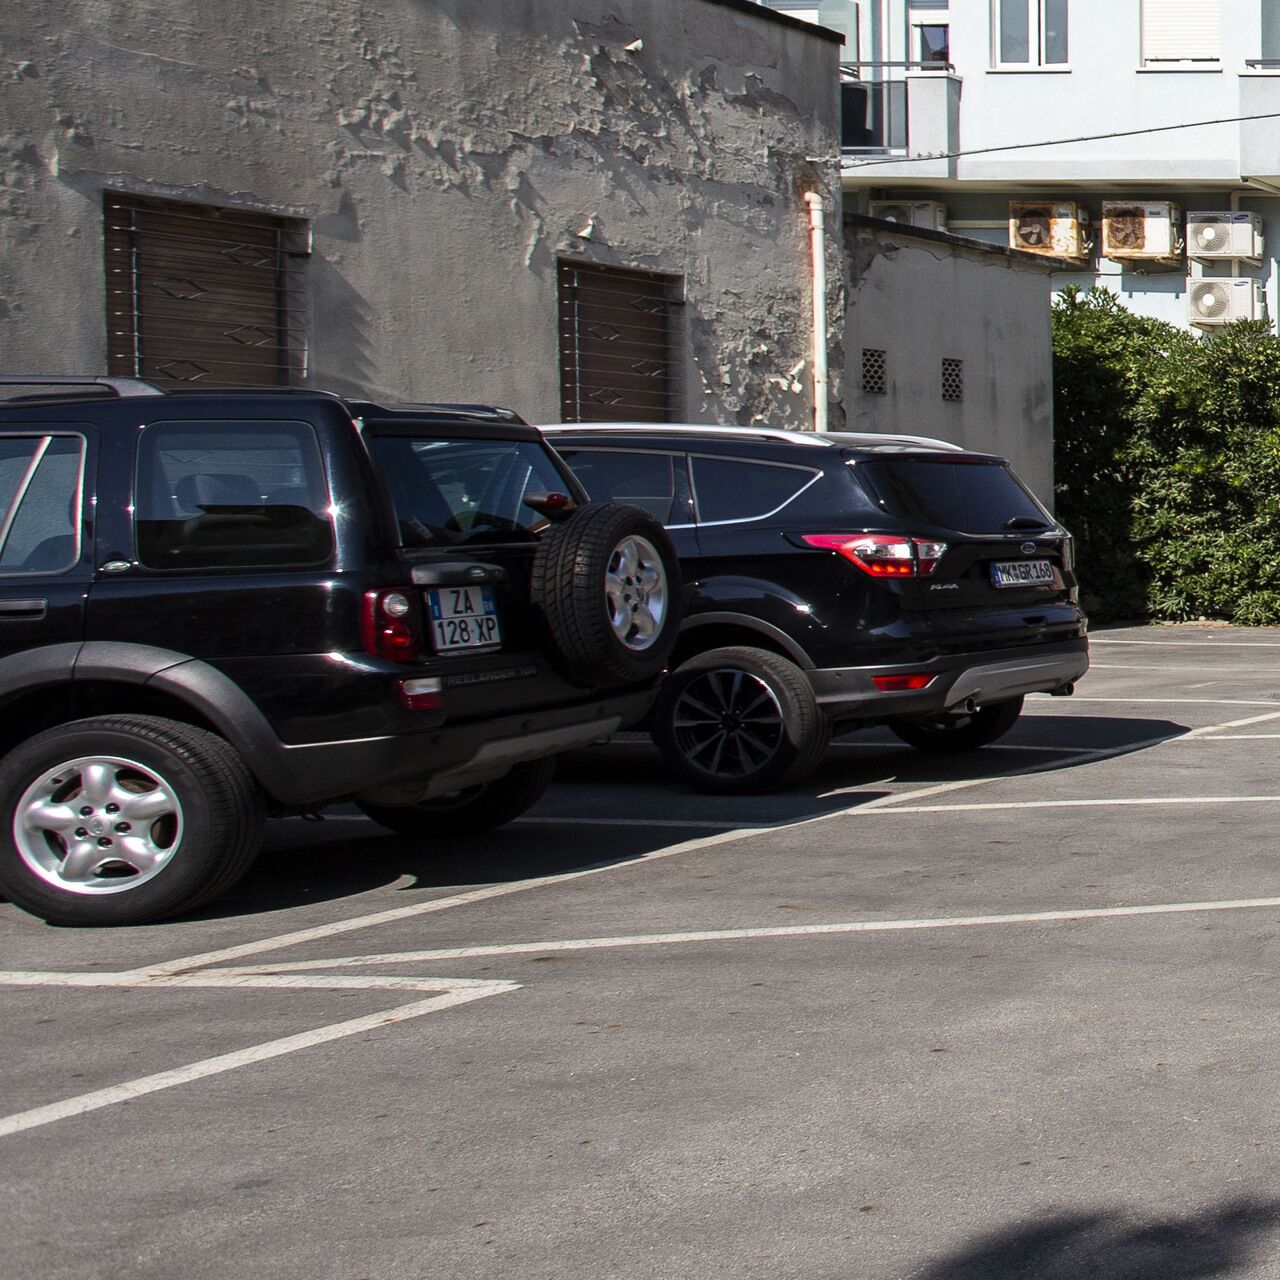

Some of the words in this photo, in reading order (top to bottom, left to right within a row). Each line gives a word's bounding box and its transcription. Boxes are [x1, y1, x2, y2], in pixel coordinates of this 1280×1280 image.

[1018, 563, 1033, 580] GR
[1033, 563, 1051, 579] 168
[450, 589, 474, 614] ZA
